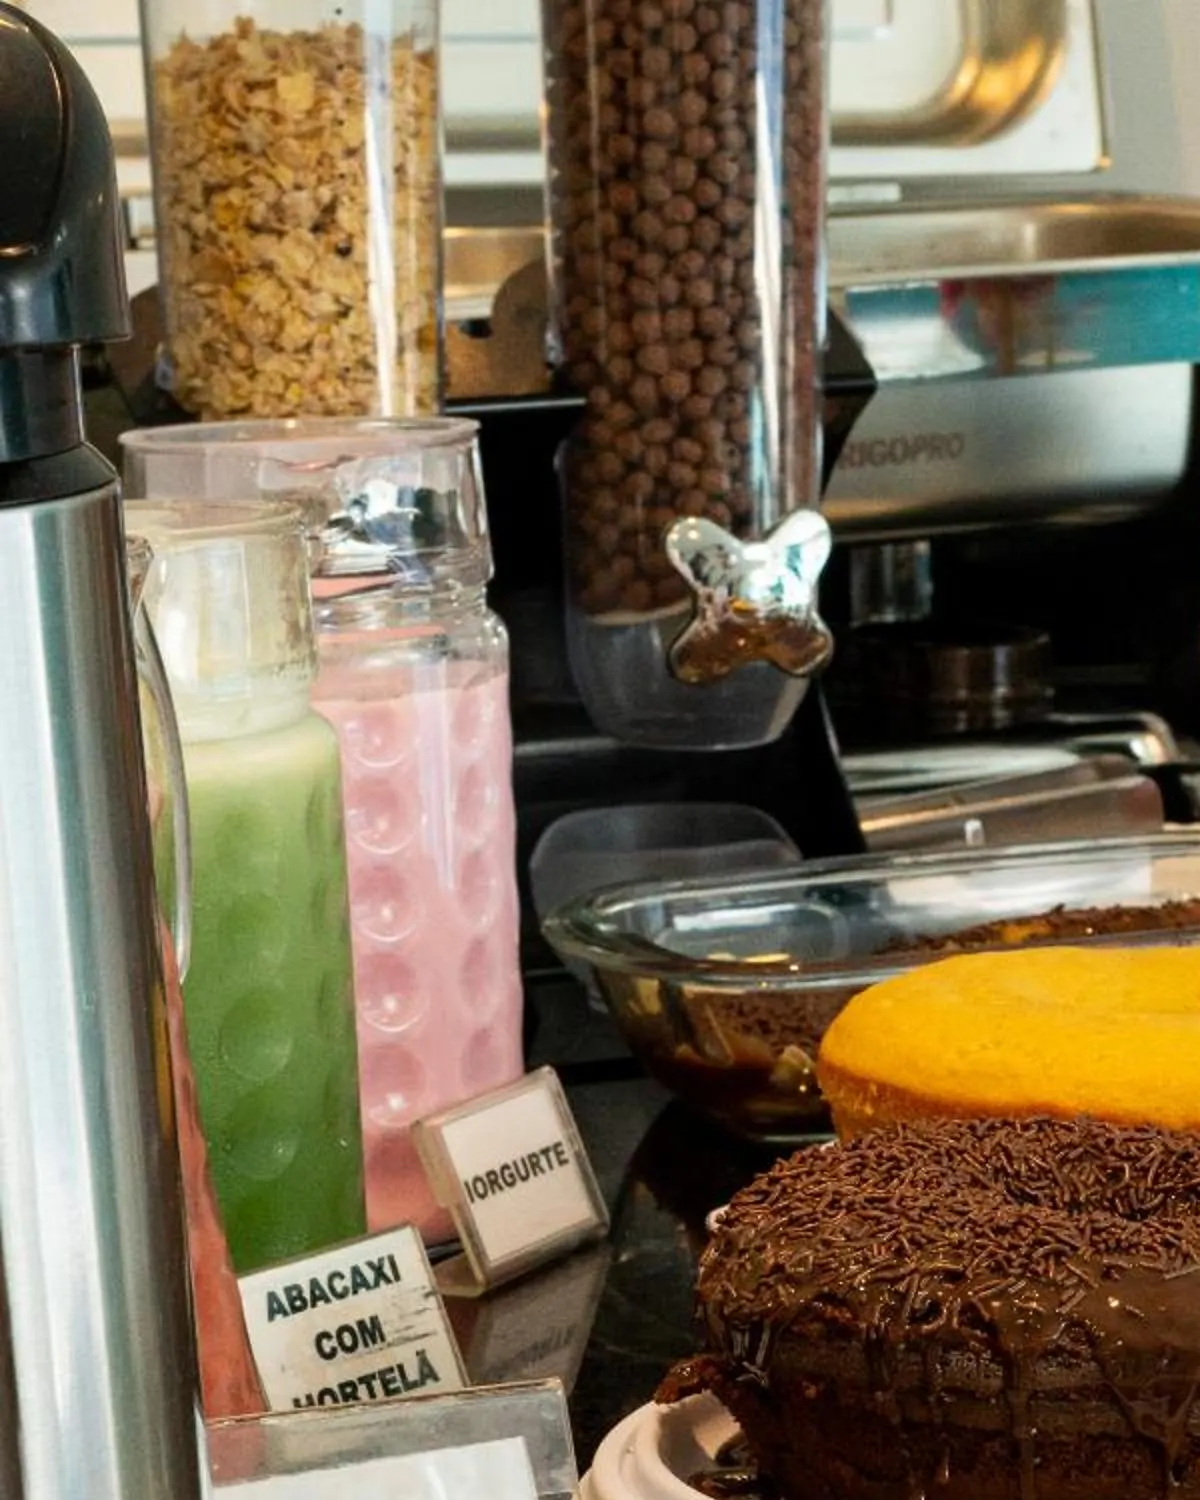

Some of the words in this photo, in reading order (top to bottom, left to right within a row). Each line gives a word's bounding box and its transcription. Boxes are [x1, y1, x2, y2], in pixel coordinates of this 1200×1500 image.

[464, 1141, 570, 1204] IORGURTE
[266, 1254, 401, 1323] ABACAXI
[314, 1315, 386, 1361] COM
